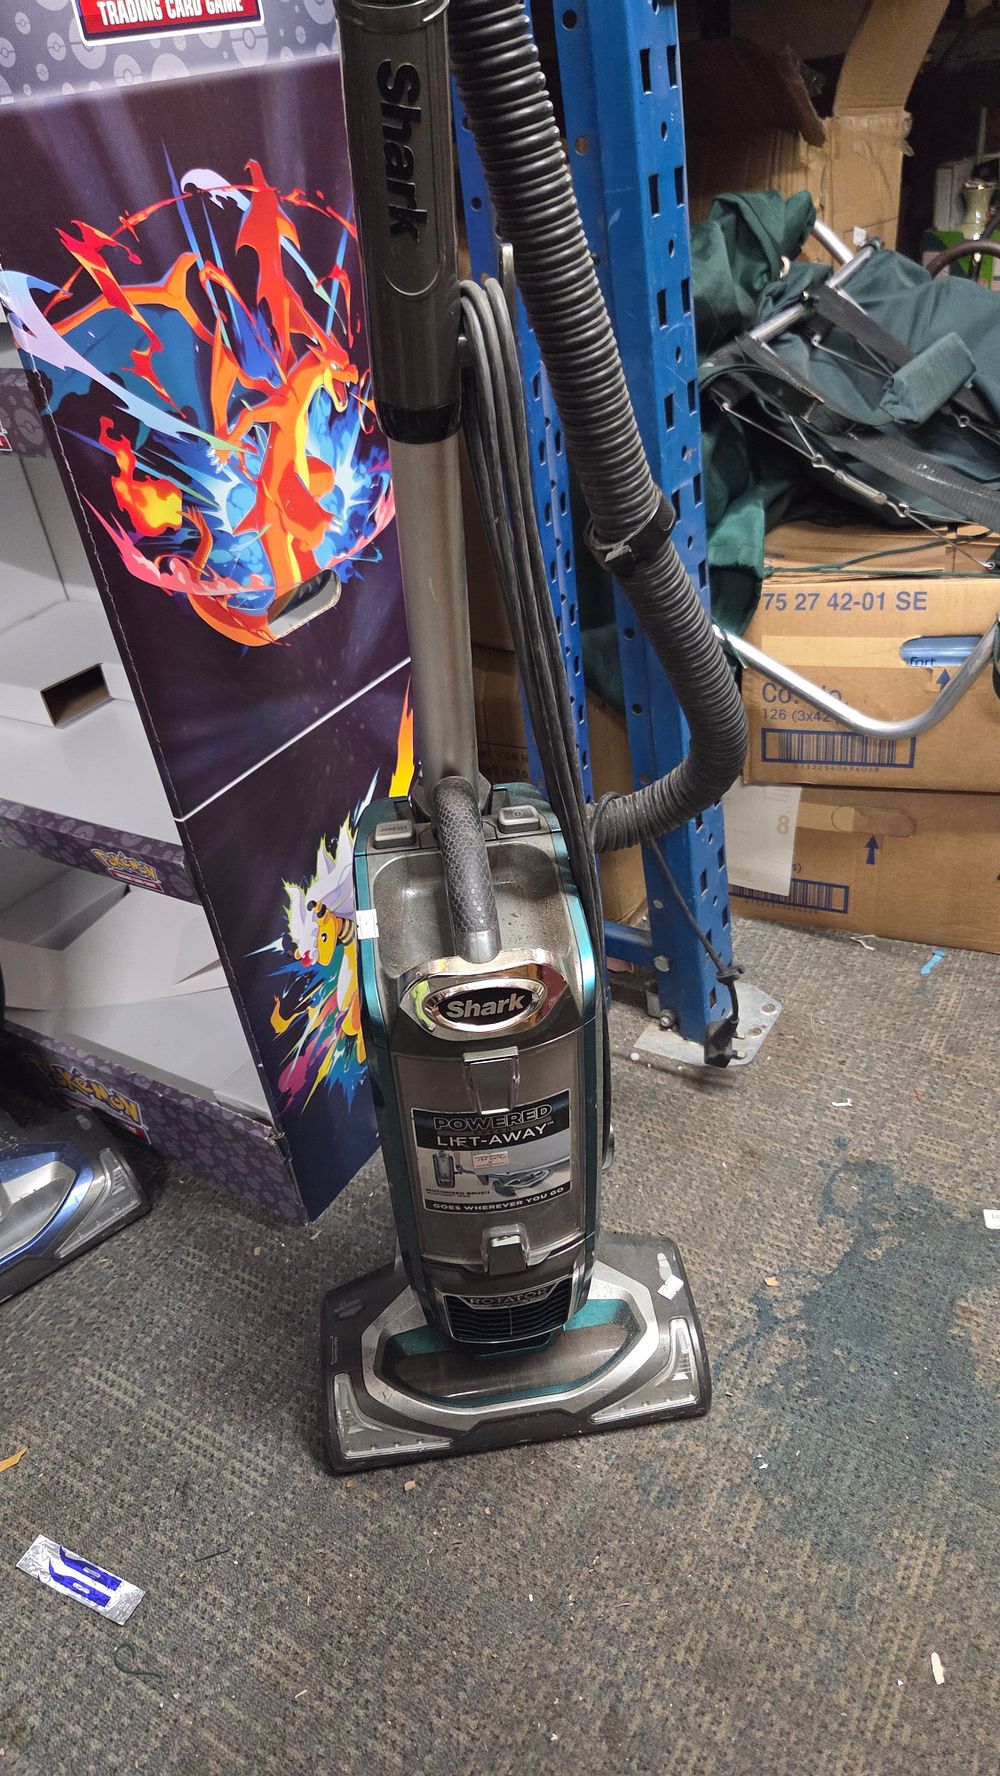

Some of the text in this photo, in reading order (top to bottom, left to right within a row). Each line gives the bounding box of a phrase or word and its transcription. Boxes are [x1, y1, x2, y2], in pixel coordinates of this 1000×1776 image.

[97, 0, 244, 26] TRADING CARD GAME
[377, 58, 428, 243] Shark
[762, 590, 928, 611] 75 27 42-01 SE
[762, 708, 787, 721] 126
[446, 992, 525, 1019] Shark
[433, 1103, 553, 1131] POWERED
[433, 1186, 565, 1211] GOES WHEREVER YOU GO
[470, 1287, 549, 1305] ROTATOR
